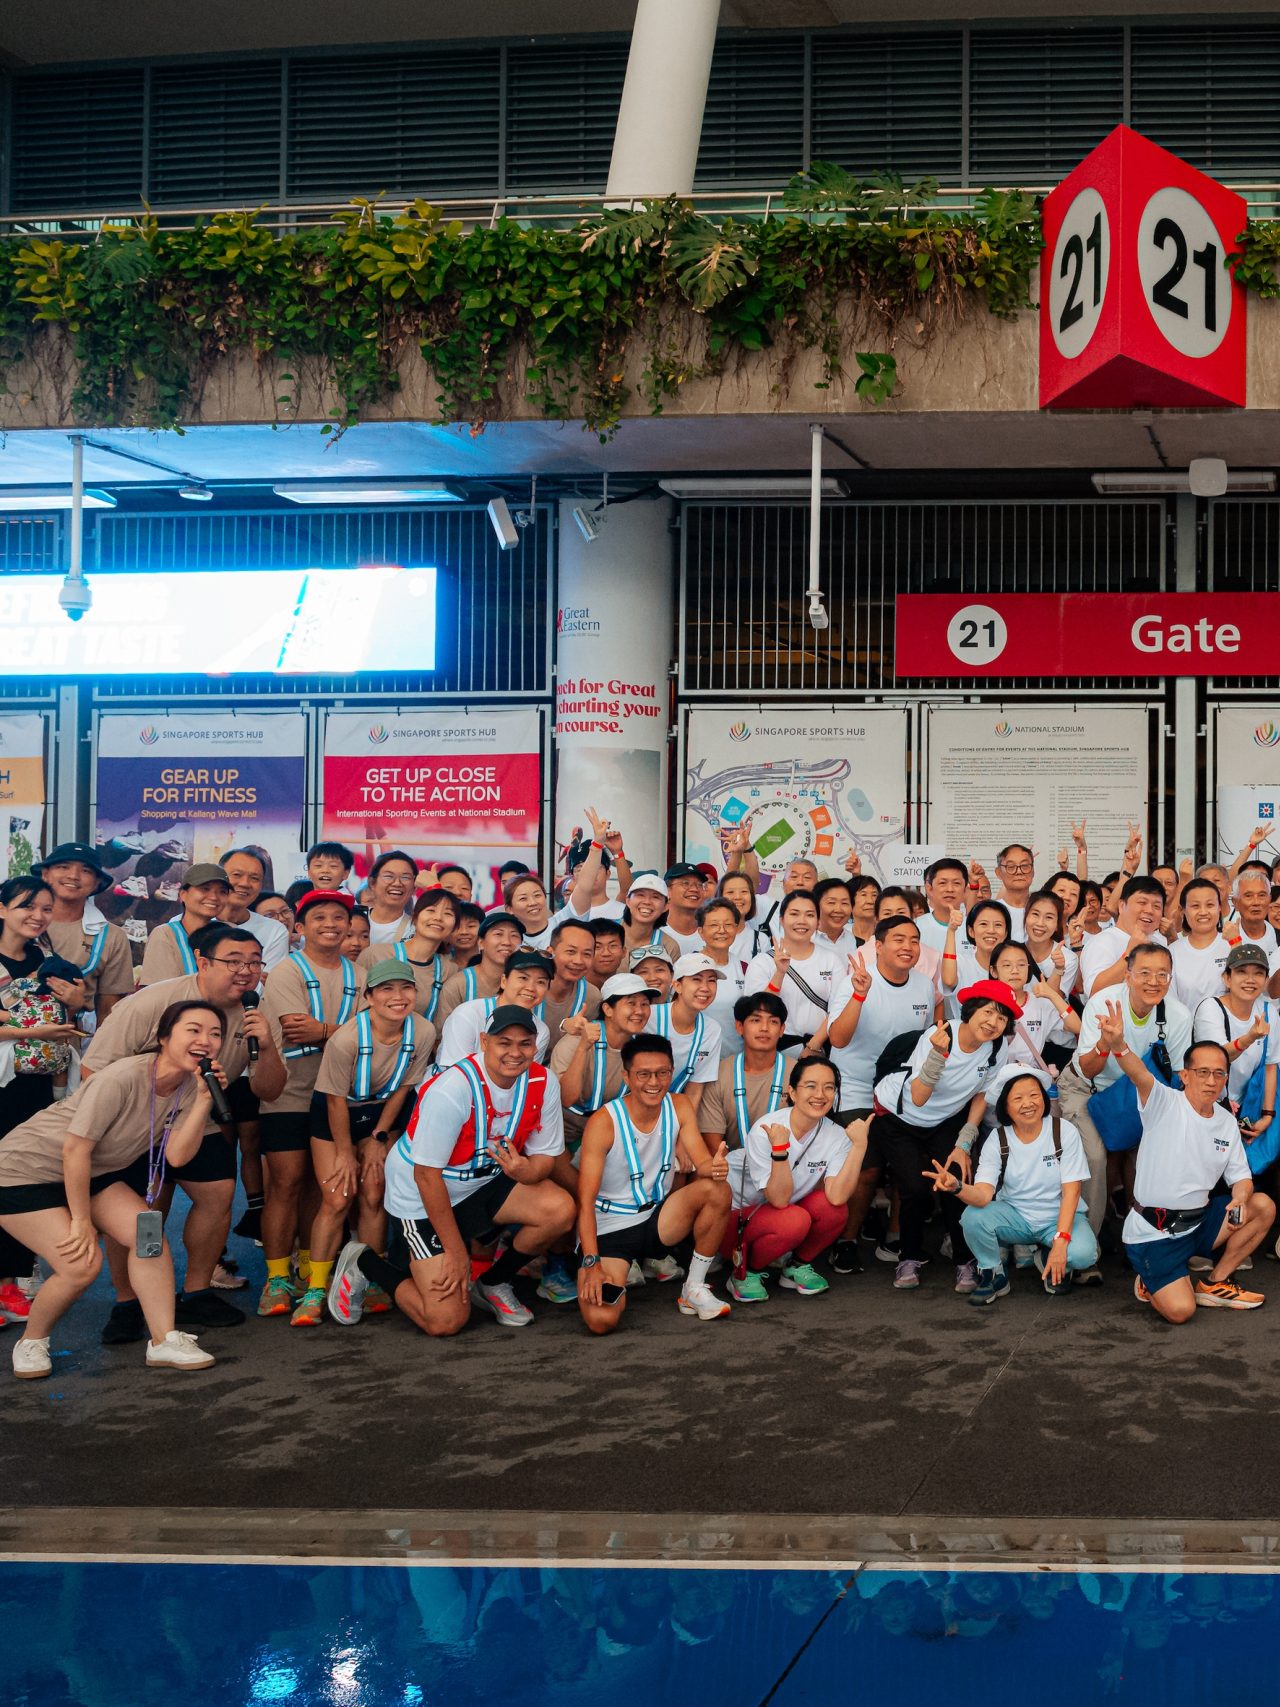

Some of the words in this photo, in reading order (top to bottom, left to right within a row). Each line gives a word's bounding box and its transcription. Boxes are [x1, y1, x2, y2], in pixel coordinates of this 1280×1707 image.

[1060, 211, 1101, 334] 21
[1153, 217, 1217, 333] 21
[563, 607, 590, 619] Great
[563, 620, 600, 632] Eastern
[958, 620, 997, 648] 21
[1131, 614, 1241, 653] Gate
[580, 677, 604, 695] for
[607, 679, 656, 698] Great
[559, 697, 620, 718] charting
[622, 702, 662, 718] your
[393, 728, 441, 738] SINGAPORE
[443, 728, 477, 738] SPORTS
[479, 728, 497, 738] HUB
[565, 720, 624, 734] course.
[755, 728, 807, 736] SINGAPORE
[809, 728, 844, 736] SPORTS
[846, 728, 866, 736] HUB
[163, 730, 210, 739] SINGAPORE
[212, 730, 244, 739] SPORTS
[246, 730, 264, 739] HUB
[161, 769, 209, 784] GEAR
[214, 769, 239, 784] UP
[366, 768, 402, 784] GET
[405, 768, 431, 783] UP
[436, 767, 496, 783] CLOSE
[143, 788, 179, 803] FOR
[184, 788, 257, 803] FITNESS
[360, 787, 386, 802] TO
[390, 787, 425, 802] THE
[430, 786, 501, 802] ACTION
[141, 810, 176, 820] Shopping
[178, 810, 187, 818] at
[188, 810, 216, 820] Kallang
[218, 810, 239, 818] Wave
[241, 810, 257, 818] Mall
[337, 809, 384, 818] International
[385, 809, 418, 819] Sporting
[420, 809, 446, 818] Events
[448, 809, 457, 817] at
[458, 808, 491, 817] National
[493, 808, 526, 817] Stadium
[903, 856, 930, 865] GAME
[893, 867, 925, 876] STATIO
